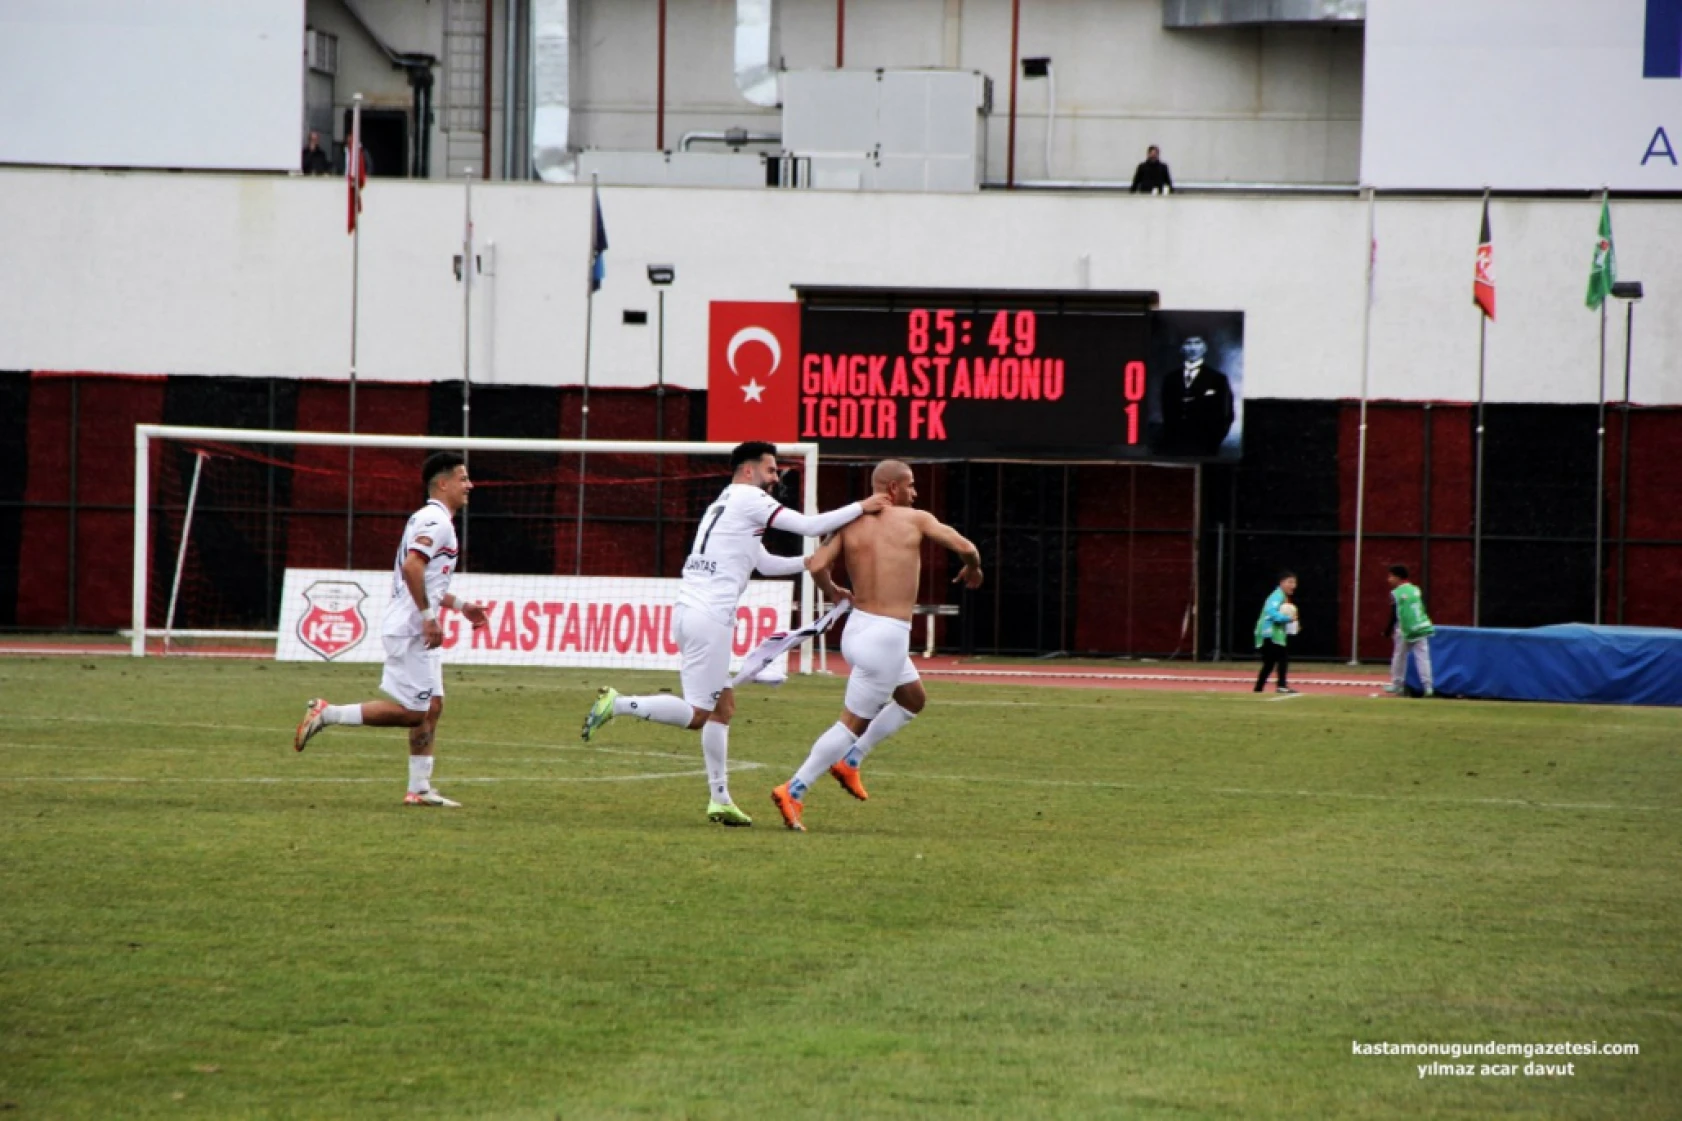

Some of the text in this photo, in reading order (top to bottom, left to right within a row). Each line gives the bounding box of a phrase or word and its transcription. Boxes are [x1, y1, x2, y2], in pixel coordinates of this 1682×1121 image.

[988, 310, 1036, 355] 49
[802, 354, 1145, 400] GMGKASTAMONU 0
[802, 399, 1140, 444] IGDIR FK 1
[308, 620, 354, 642] KS
